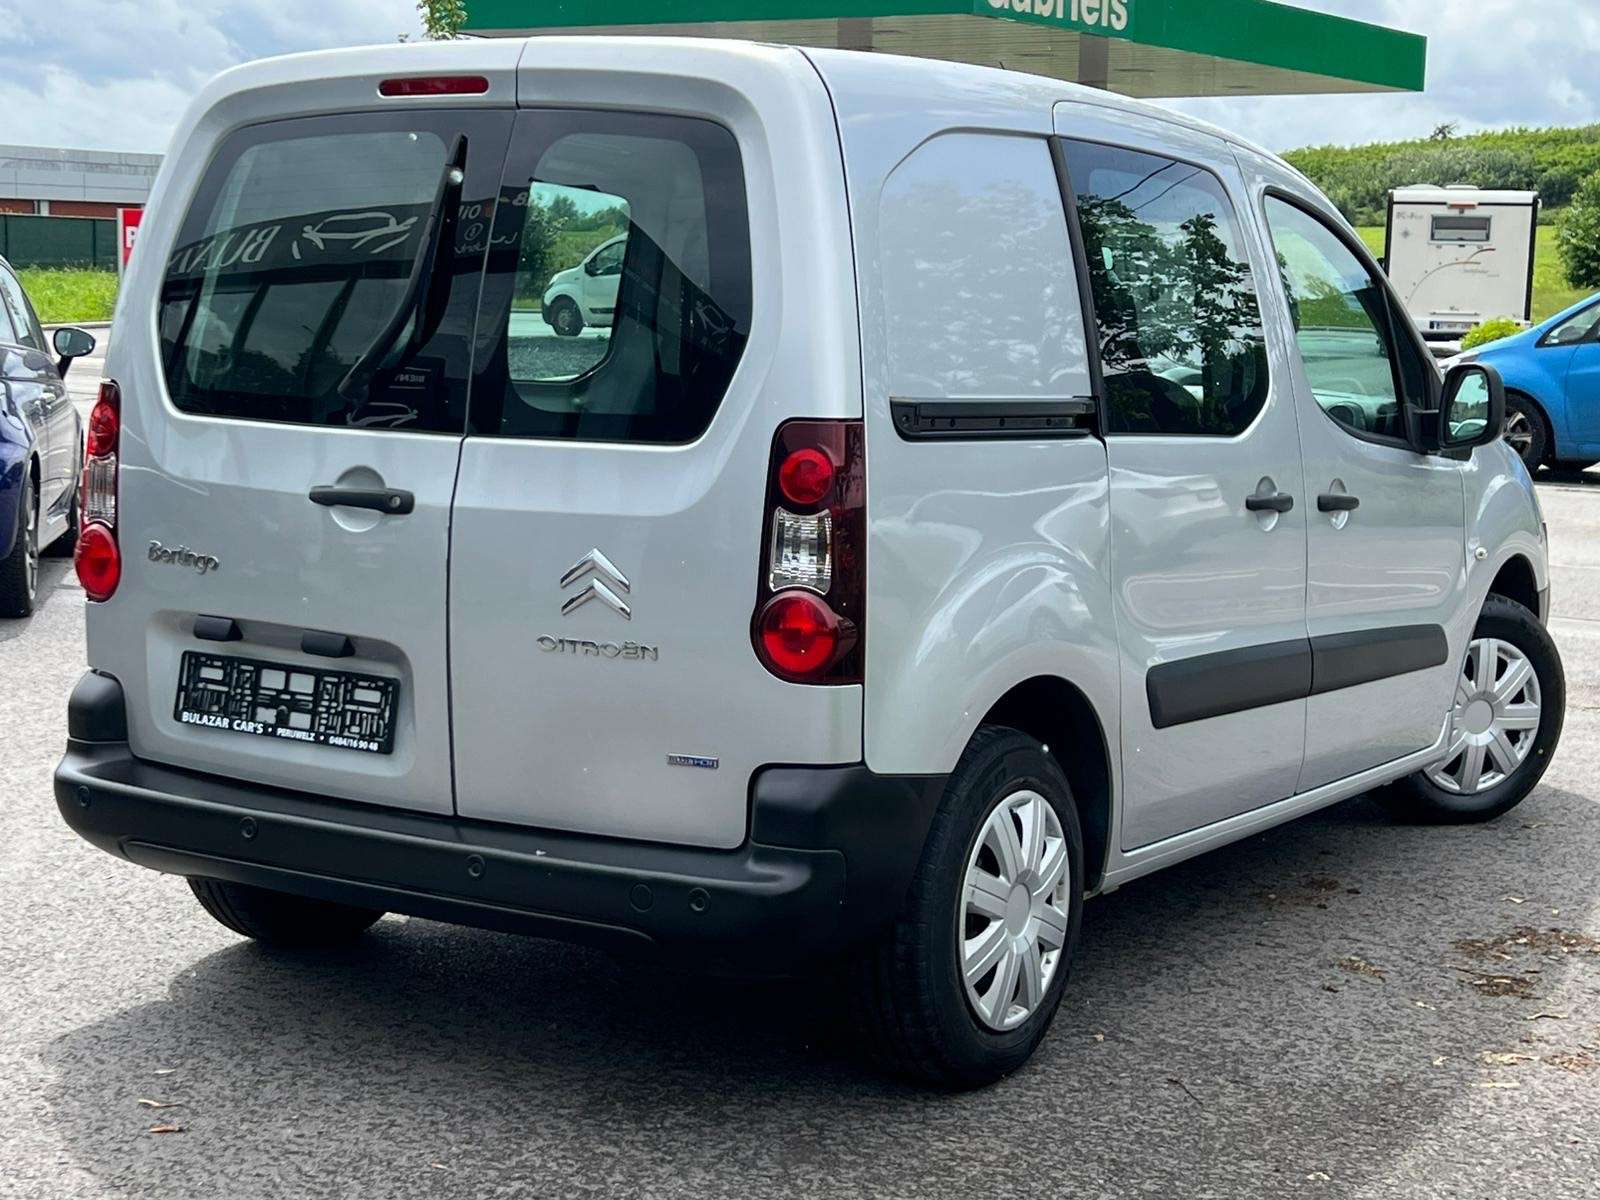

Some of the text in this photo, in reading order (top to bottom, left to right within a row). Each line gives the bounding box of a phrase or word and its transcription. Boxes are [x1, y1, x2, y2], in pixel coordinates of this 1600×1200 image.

[988, 0, 1128, 31] riels
[148, 540, 220, 575] Berlingo
[537, 634, 658, 661] CITROËN
[181, 711, 230, 729] BULAZAR
[232, 719, 264, 734] CAR'S
